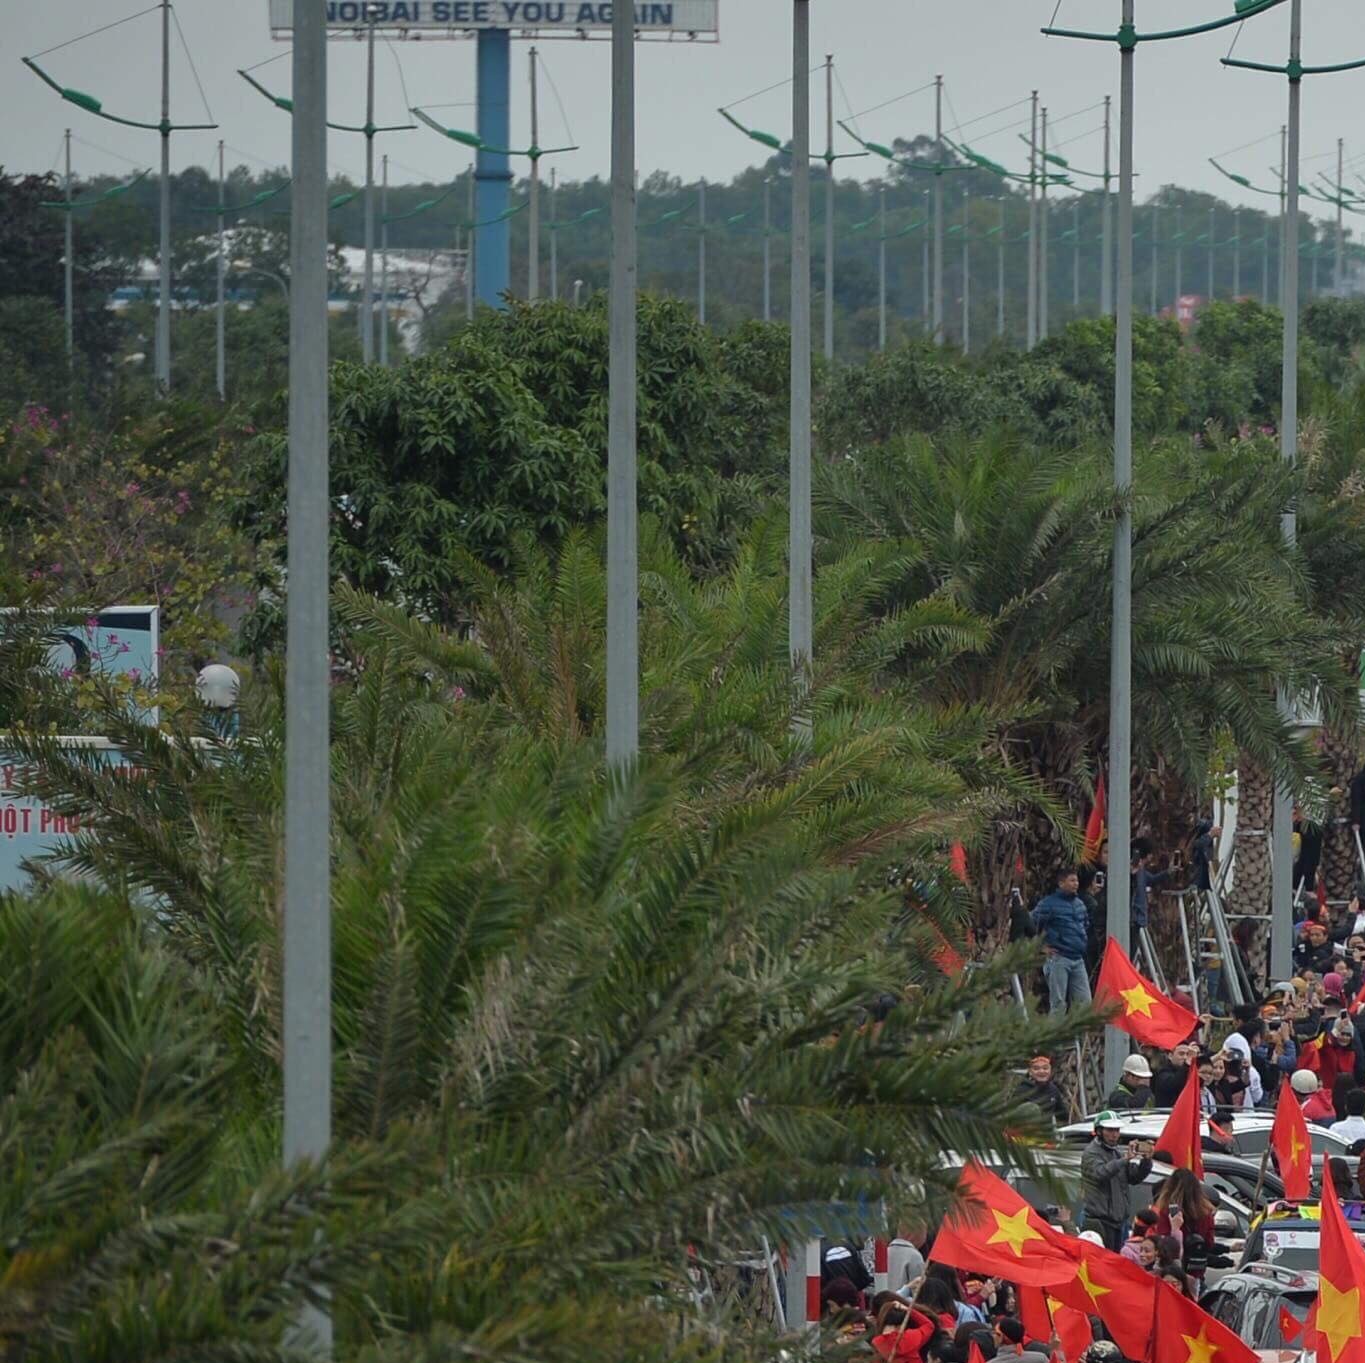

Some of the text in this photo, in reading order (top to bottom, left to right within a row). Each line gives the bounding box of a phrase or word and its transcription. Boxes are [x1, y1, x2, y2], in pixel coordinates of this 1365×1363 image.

[432, 2, 493, 22] SEE
[503, 2, 564, 23] YOU
[576, 3, 673, 24] AGIN
[0, 804, 32, 838] ỘT
